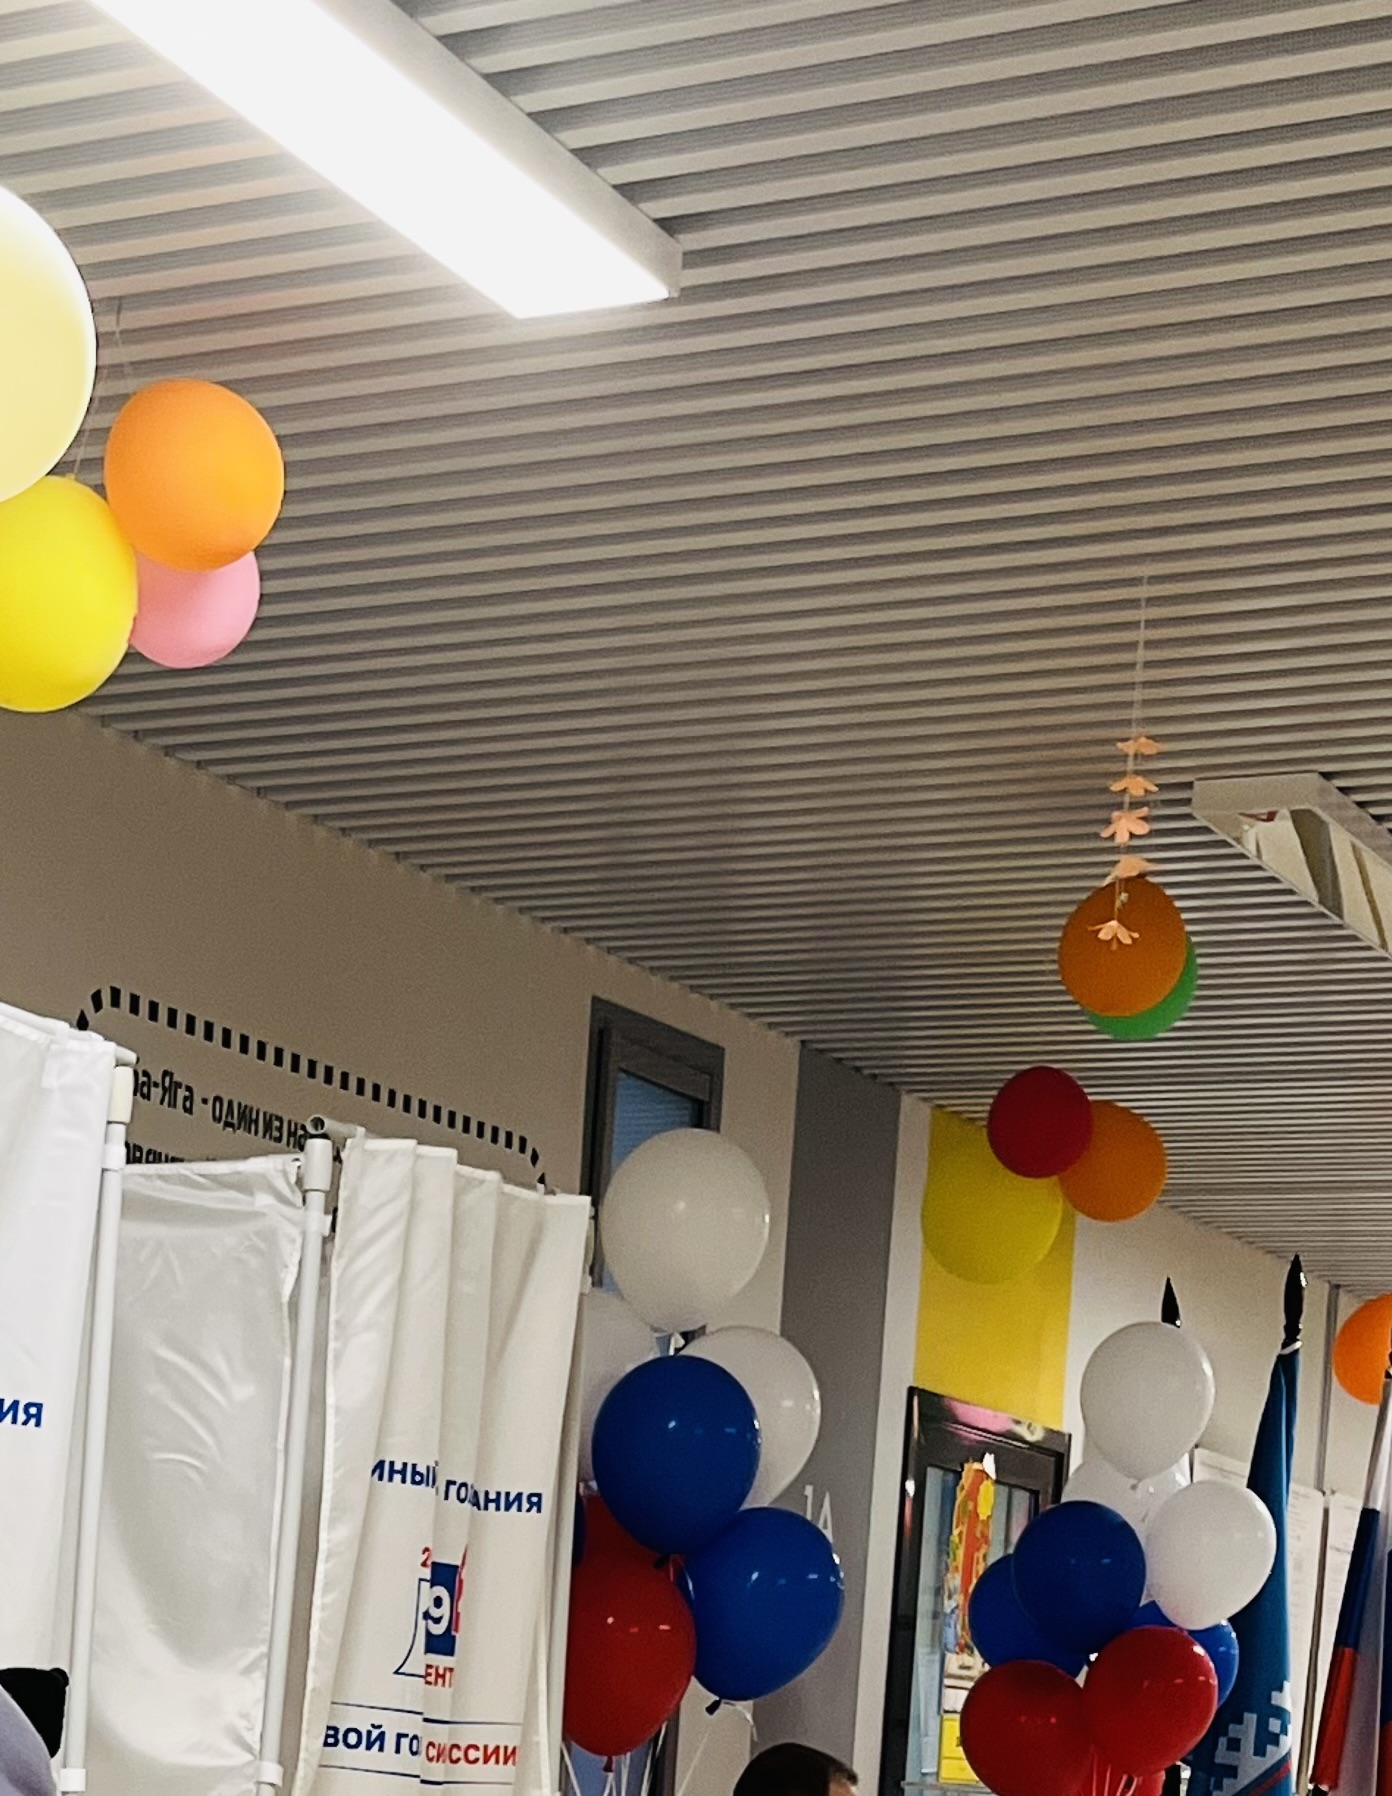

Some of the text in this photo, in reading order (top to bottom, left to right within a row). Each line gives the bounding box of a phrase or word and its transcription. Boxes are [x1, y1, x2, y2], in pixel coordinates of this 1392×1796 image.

[212, 1095, 259, 1137] один
[263, 1110, 284, 1144] из
[323, 1723, 385, 1752] ВОЙ
[394, 1732, 421, 1757] ГО
